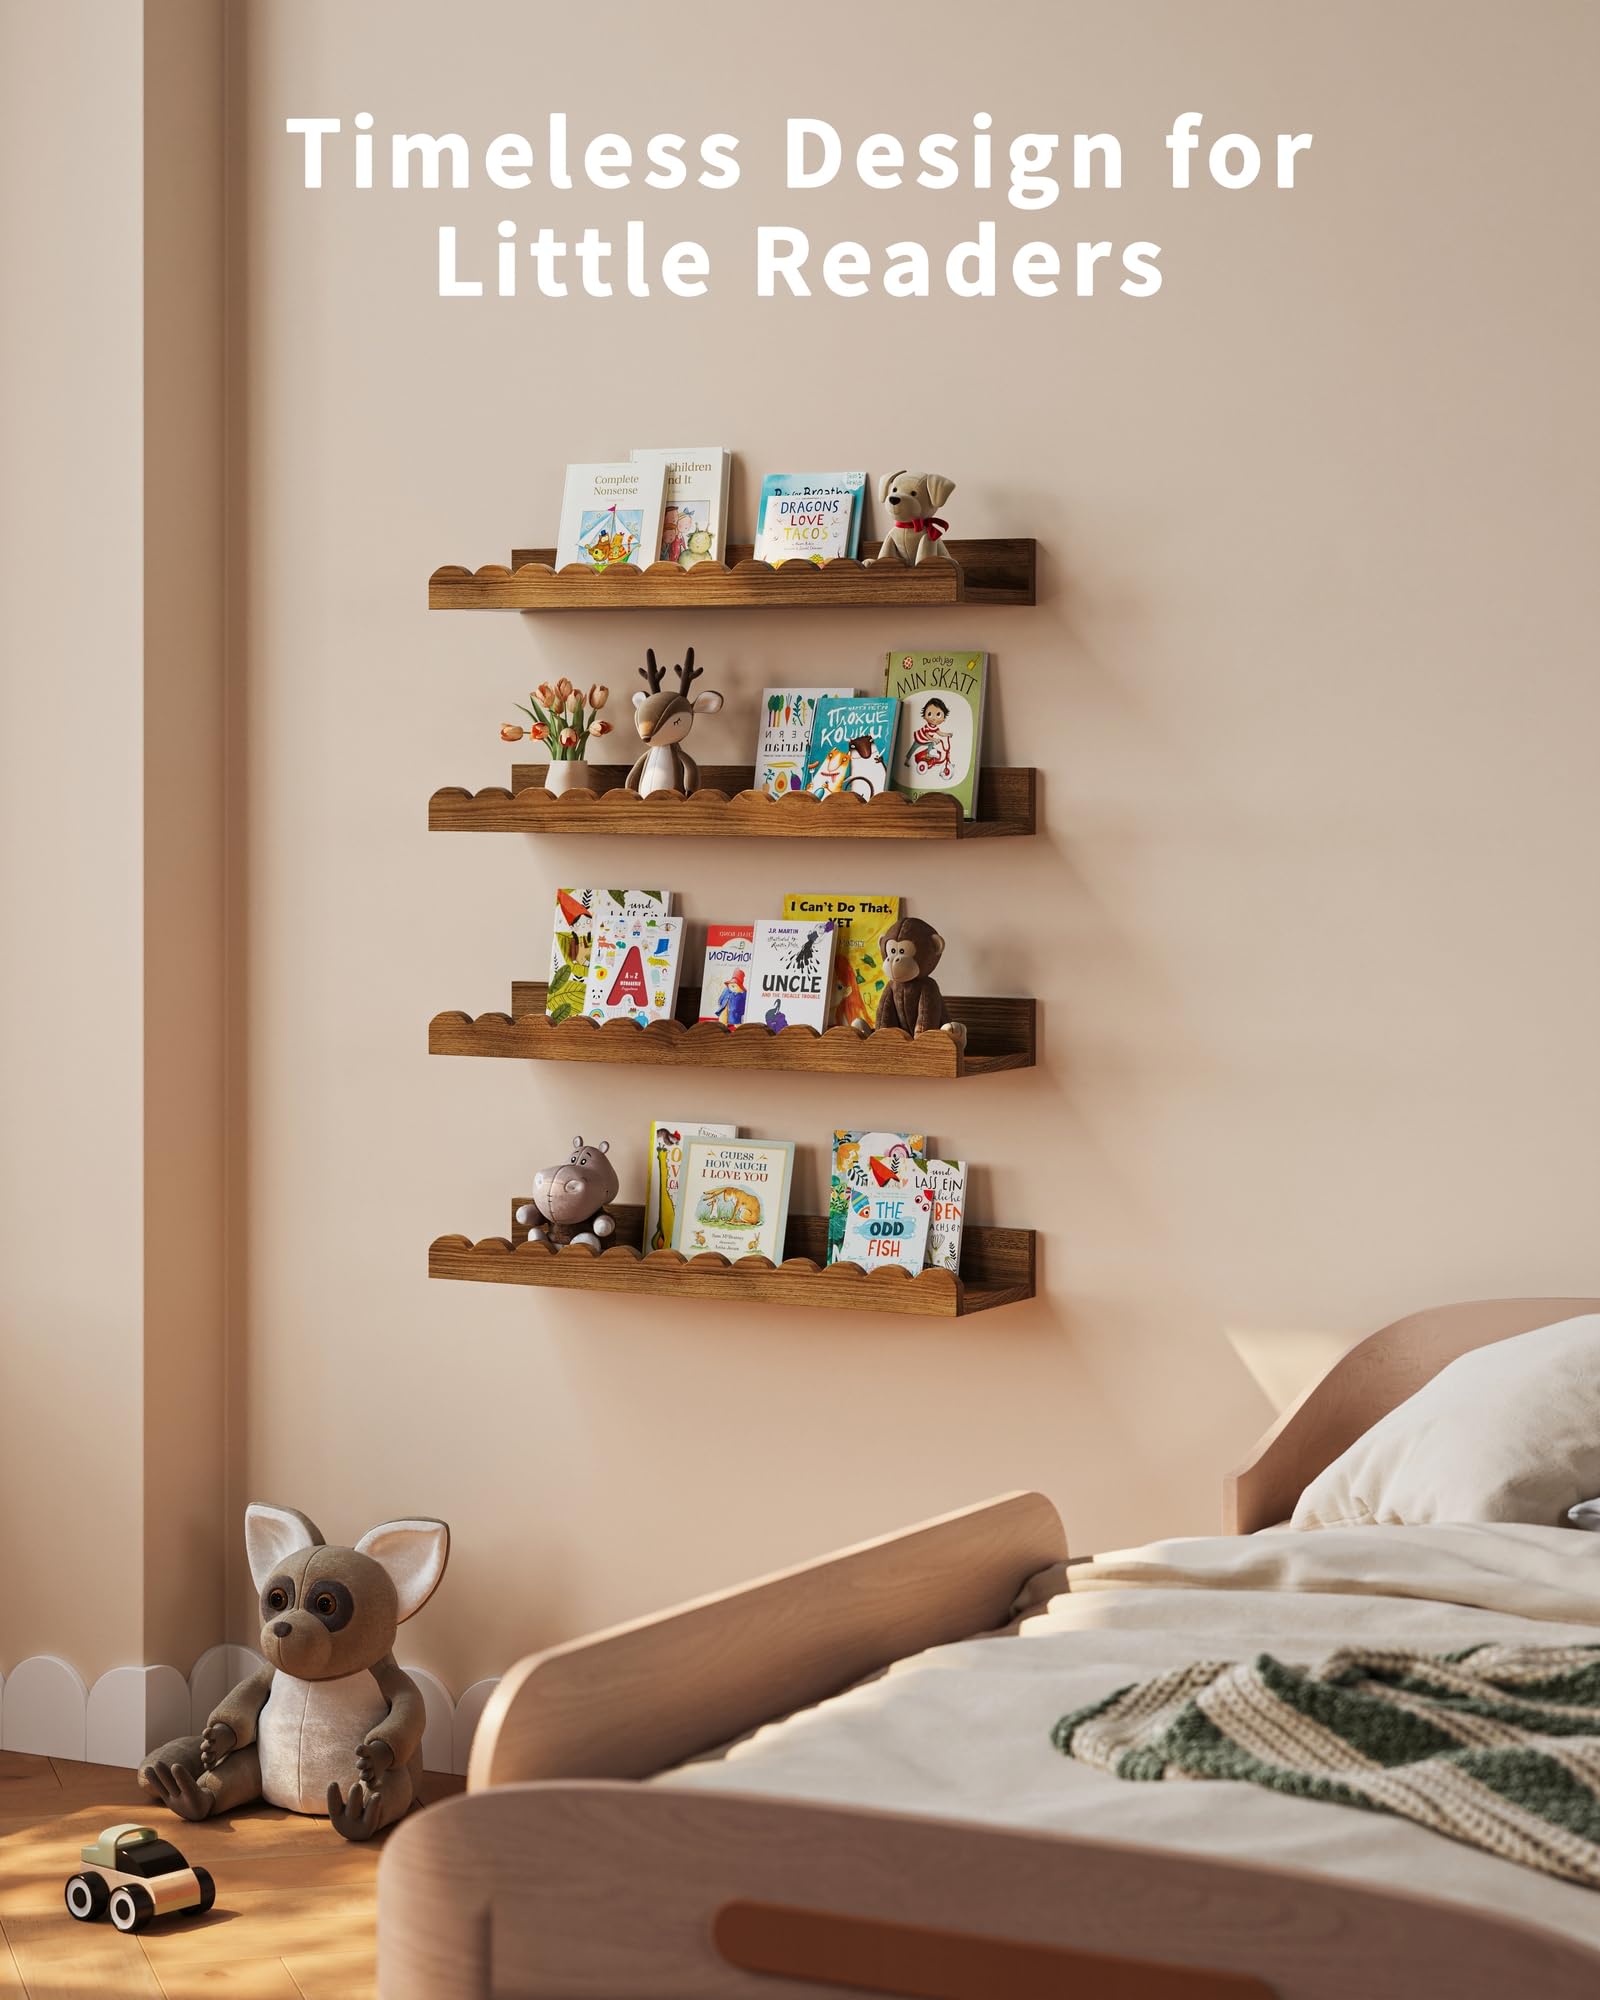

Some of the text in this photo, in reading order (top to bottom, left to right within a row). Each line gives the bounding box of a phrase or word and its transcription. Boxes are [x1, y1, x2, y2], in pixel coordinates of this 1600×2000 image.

[594, 475, 639, 486] Complete
[684, 475, 691, 484] It
[593, 487, 638, 496] Nonsense
[780, 500, 839, 514] DRAGONS
[790, 514, 825, 526] LOVE
[784, 527, 829, 541] TACOS
[922, 656, 954, 667] Du och jag
[896, 667, 978, 698] MIN SKATT
[628, 900, 654, 909] und
[791, 901, 892, 914] I Can't Do That,
[762, 974, 822, 993] UNCLE
[720, 1150, 754, 1161] GUESS
[705, 1159, 768, 1172] HOW MUCH
[931, 1167, 952, 1177] und
[701, 1168, 769, 1183] I LOVE YOU
[876, 1201, 904, 1219] THE
[869, 1221, 904, 1237] ODD
[868, 1239, 901, 1257] FISH
